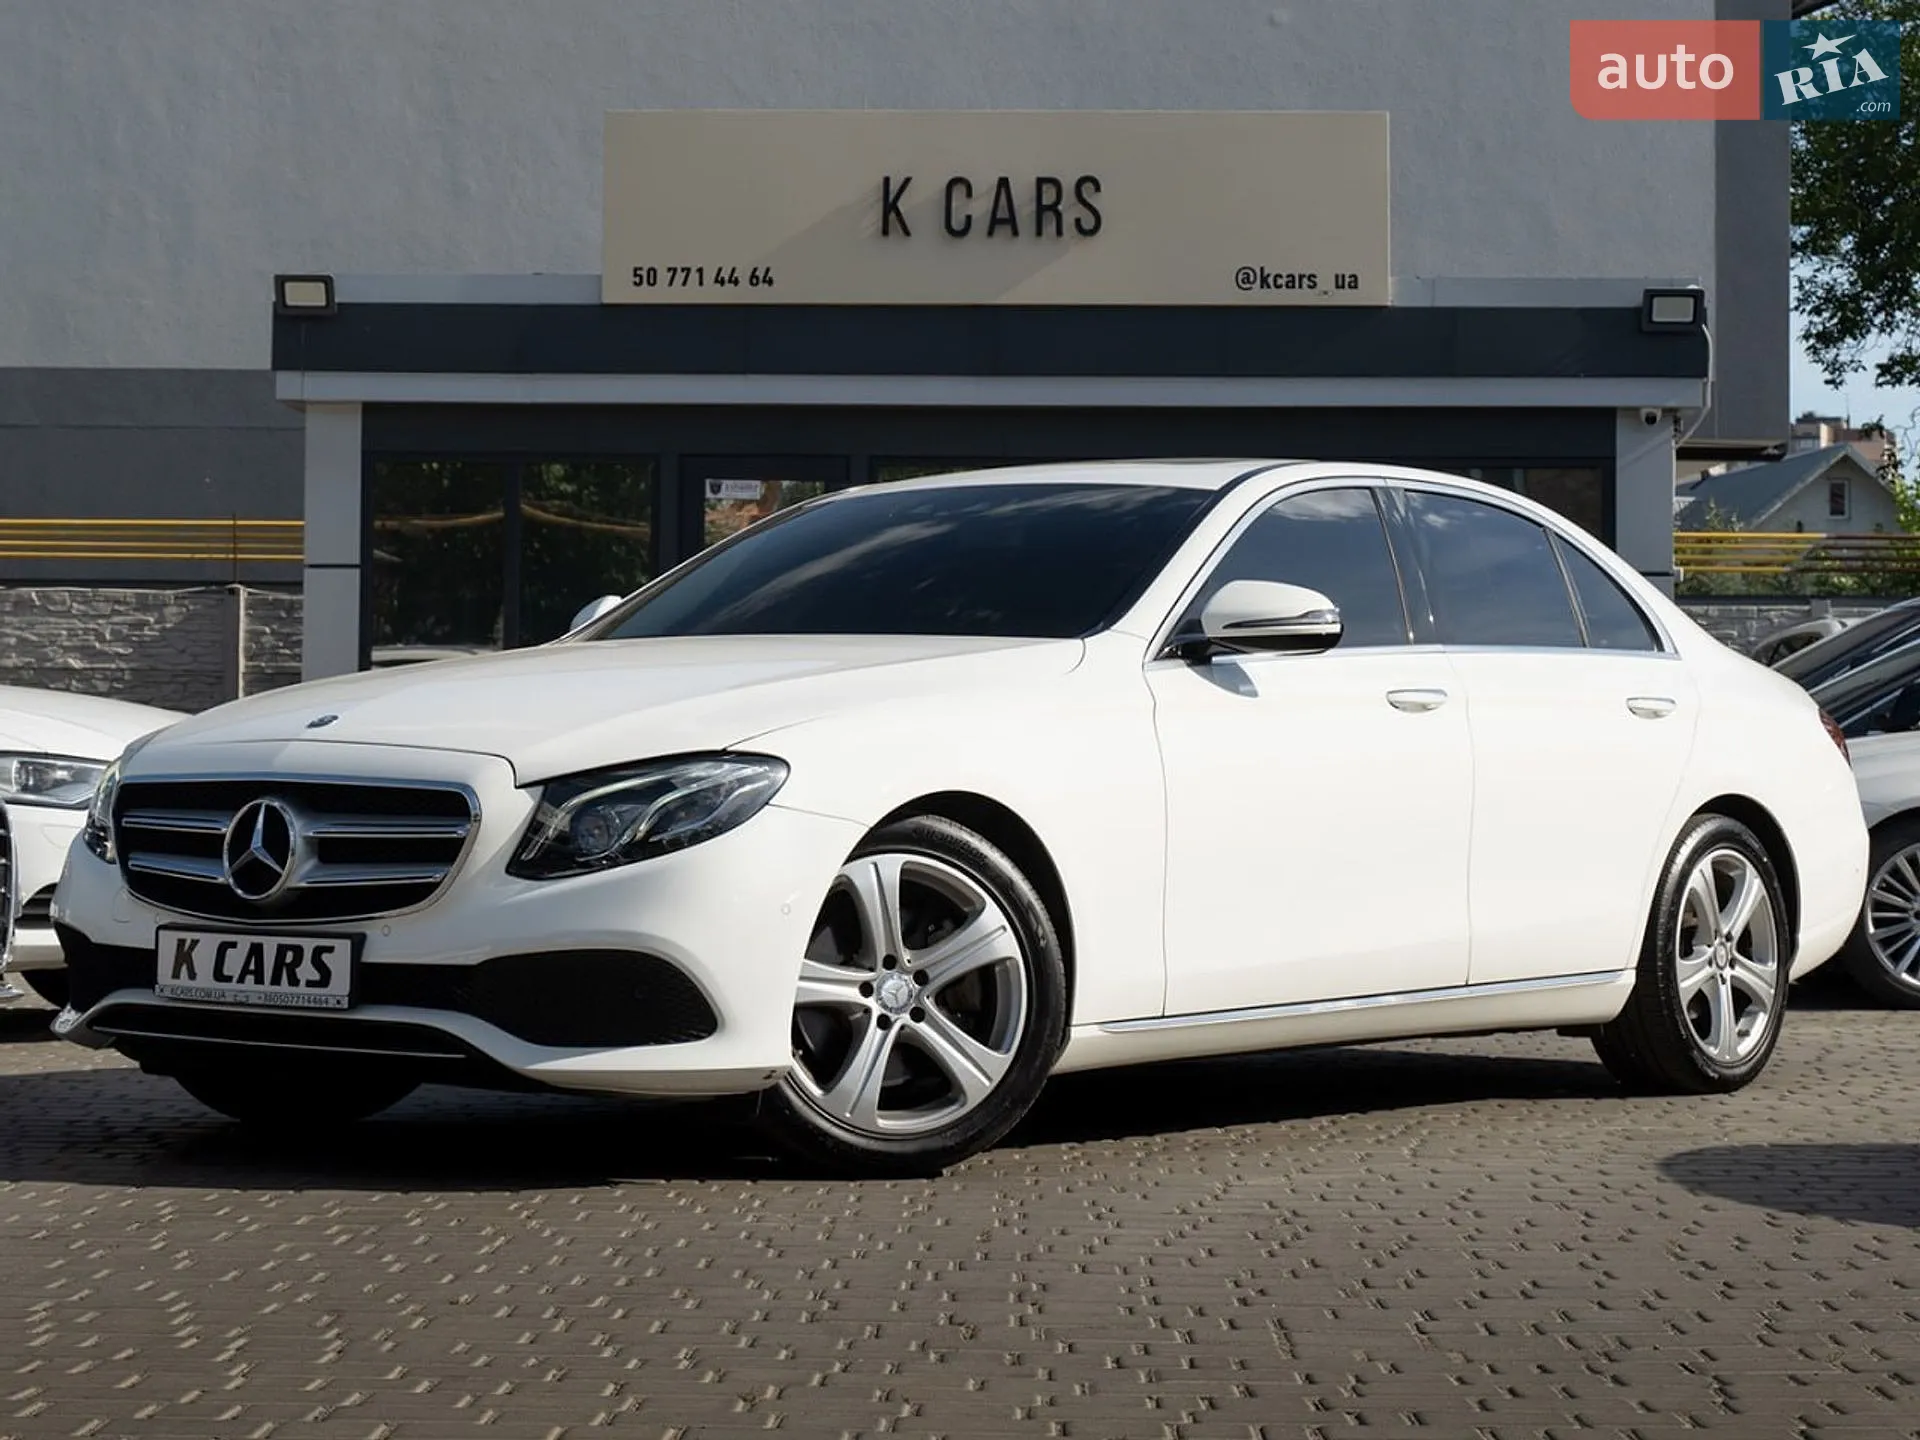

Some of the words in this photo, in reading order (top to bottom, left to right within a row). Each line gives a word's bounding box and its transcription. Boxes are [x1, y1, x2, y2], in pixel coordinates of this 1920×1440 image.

[881, 175, 913, 237] K
[944, 175, 1102, 237] CARS
[632, 266, 658, 288] 50
[667, 266, 705, 288] 771
[713, 266, 740, 288] 44
[749, 266, 775, 288] 64
[171, 938, 200, 981] K
[212, 941, 336, 989] CARS
